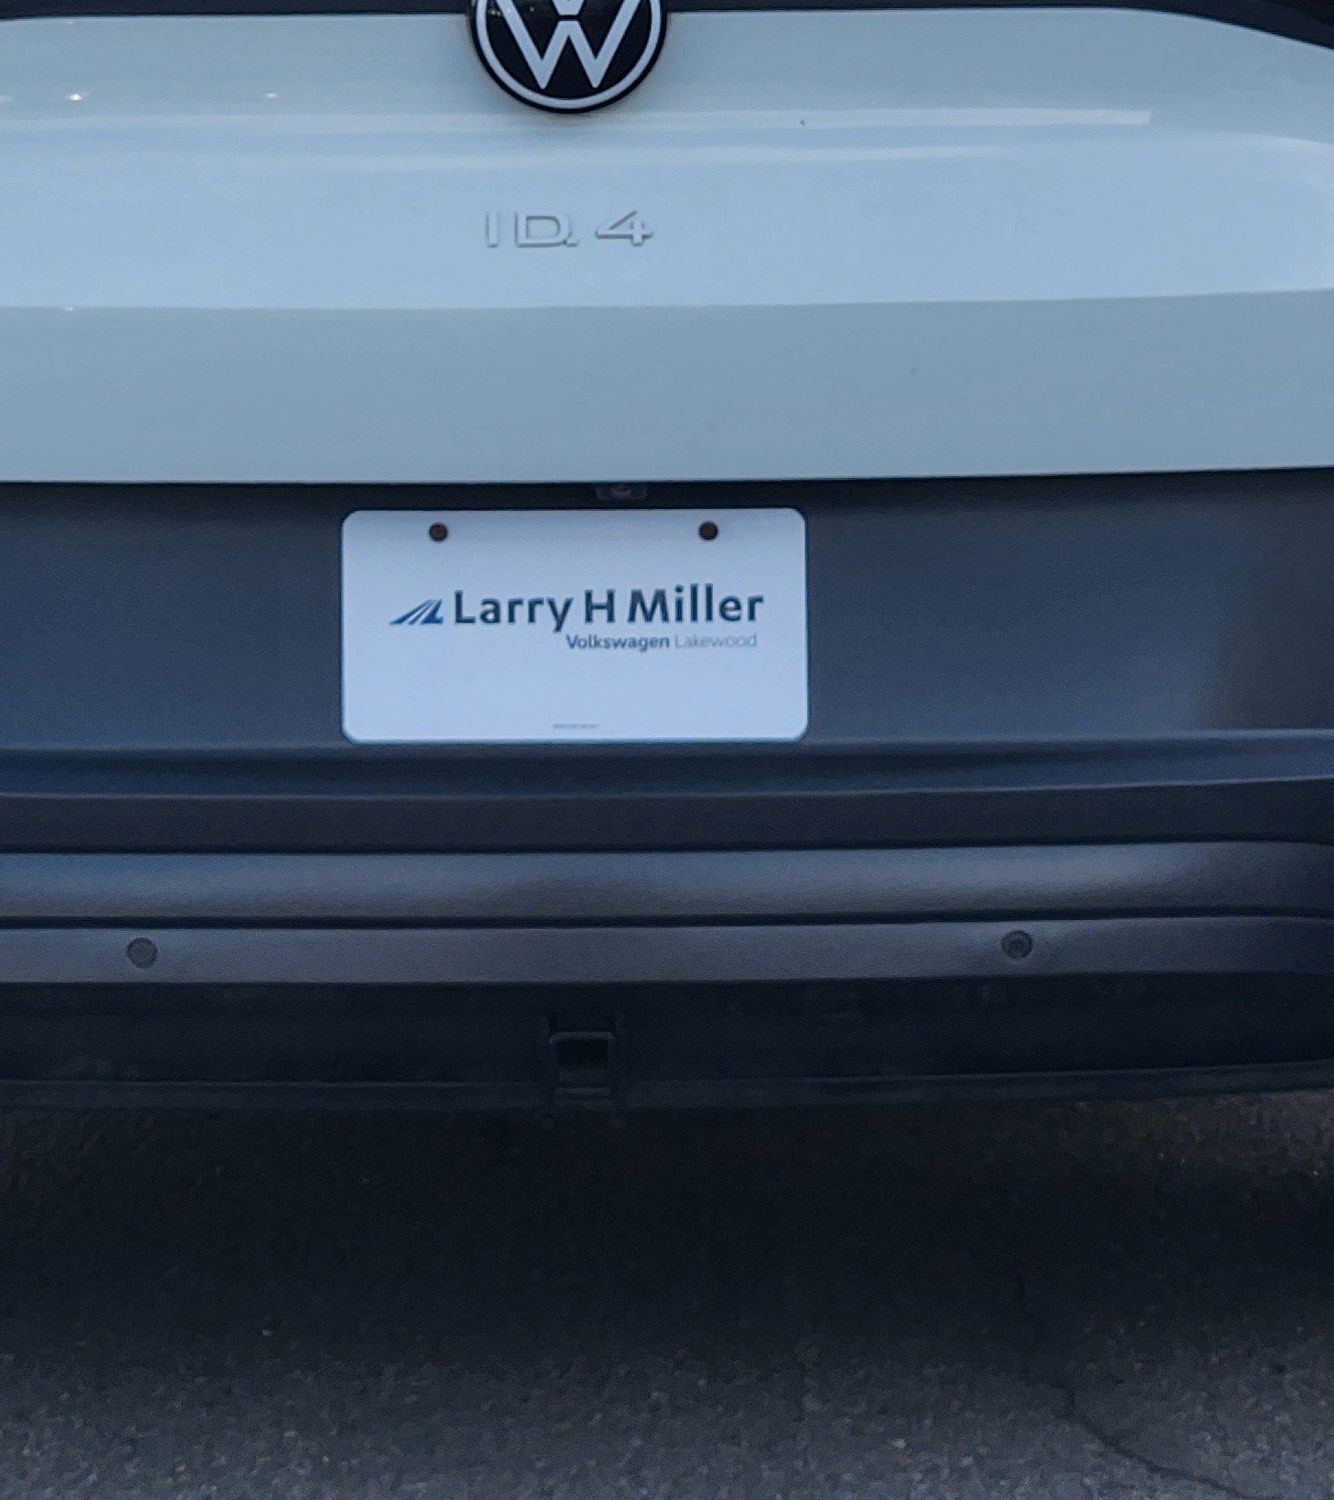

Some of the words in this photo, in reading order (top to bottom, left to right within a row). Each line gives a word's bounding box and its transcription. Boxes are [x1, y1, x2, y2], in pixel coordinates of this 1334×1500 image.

[454, 590, 574, 633] Larry
[584, 590, 615, 624] H
[627, 583, 764, 623] Miller
[567, 633, 670, 653] Volkswagen
[674, 632, 758, 649] Lakewood
